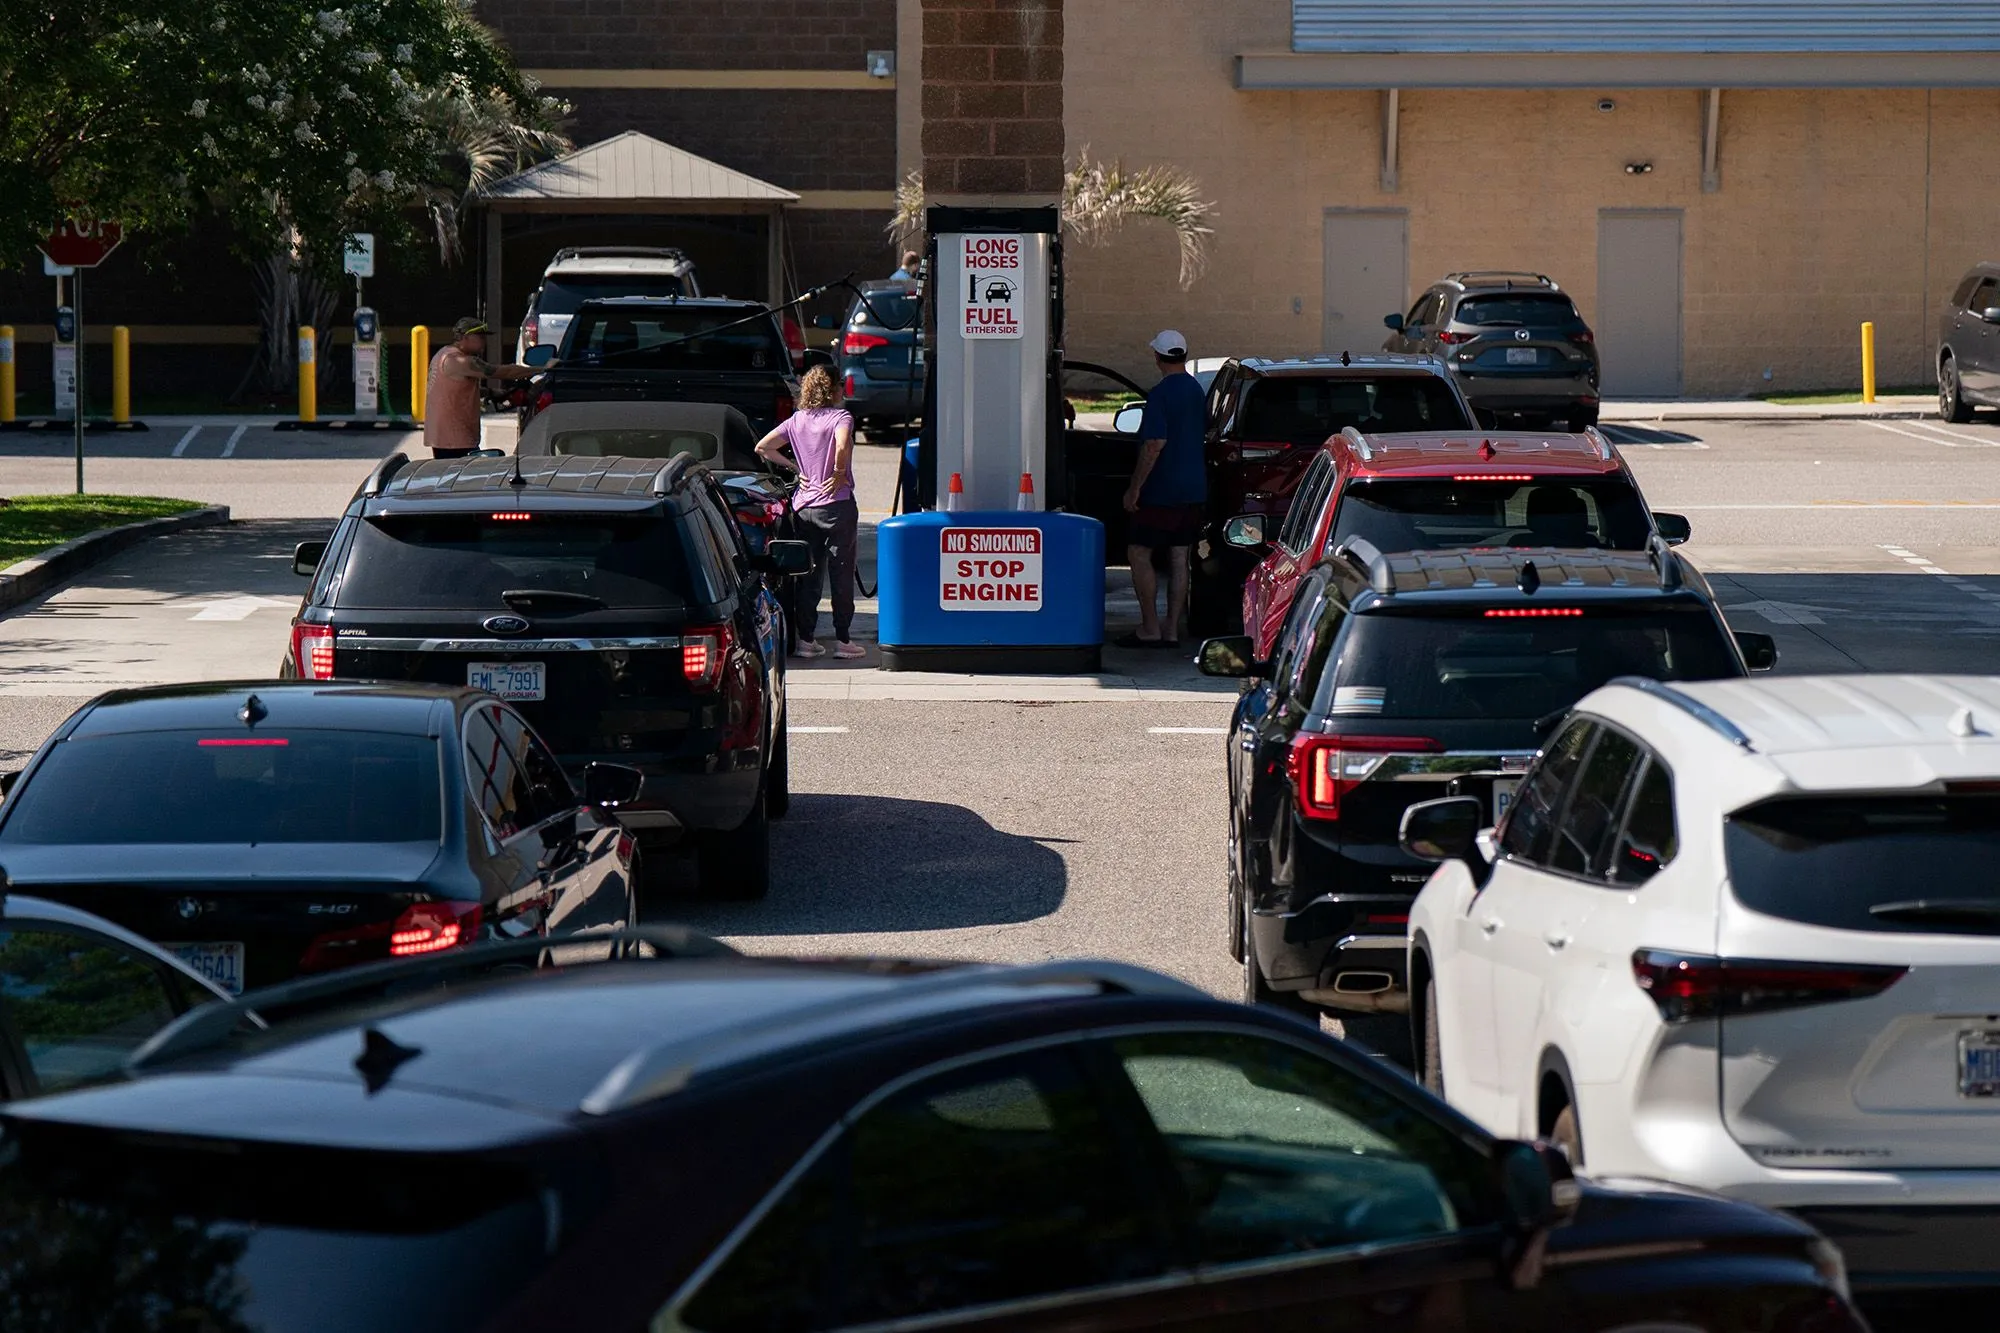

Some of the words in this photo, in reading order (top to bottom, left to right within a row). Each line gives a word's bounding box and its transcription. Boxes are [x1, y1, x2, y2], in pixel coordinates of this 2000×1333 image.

[965, 239, 1019, 254] LONG
[965, 255, 1019, 269] HOSES
[965, 308, 1018, 325] FUEL
[966, 326, 997, 334] EITHER
[998, 326, 1018, 334] SIDE
[947, 534, 967, 552] NO
[970, 534, 1035, 552] SMOKING
[957, 560, 1025, 578] STOP
[943, 583, 1039, 601] ENGINE
